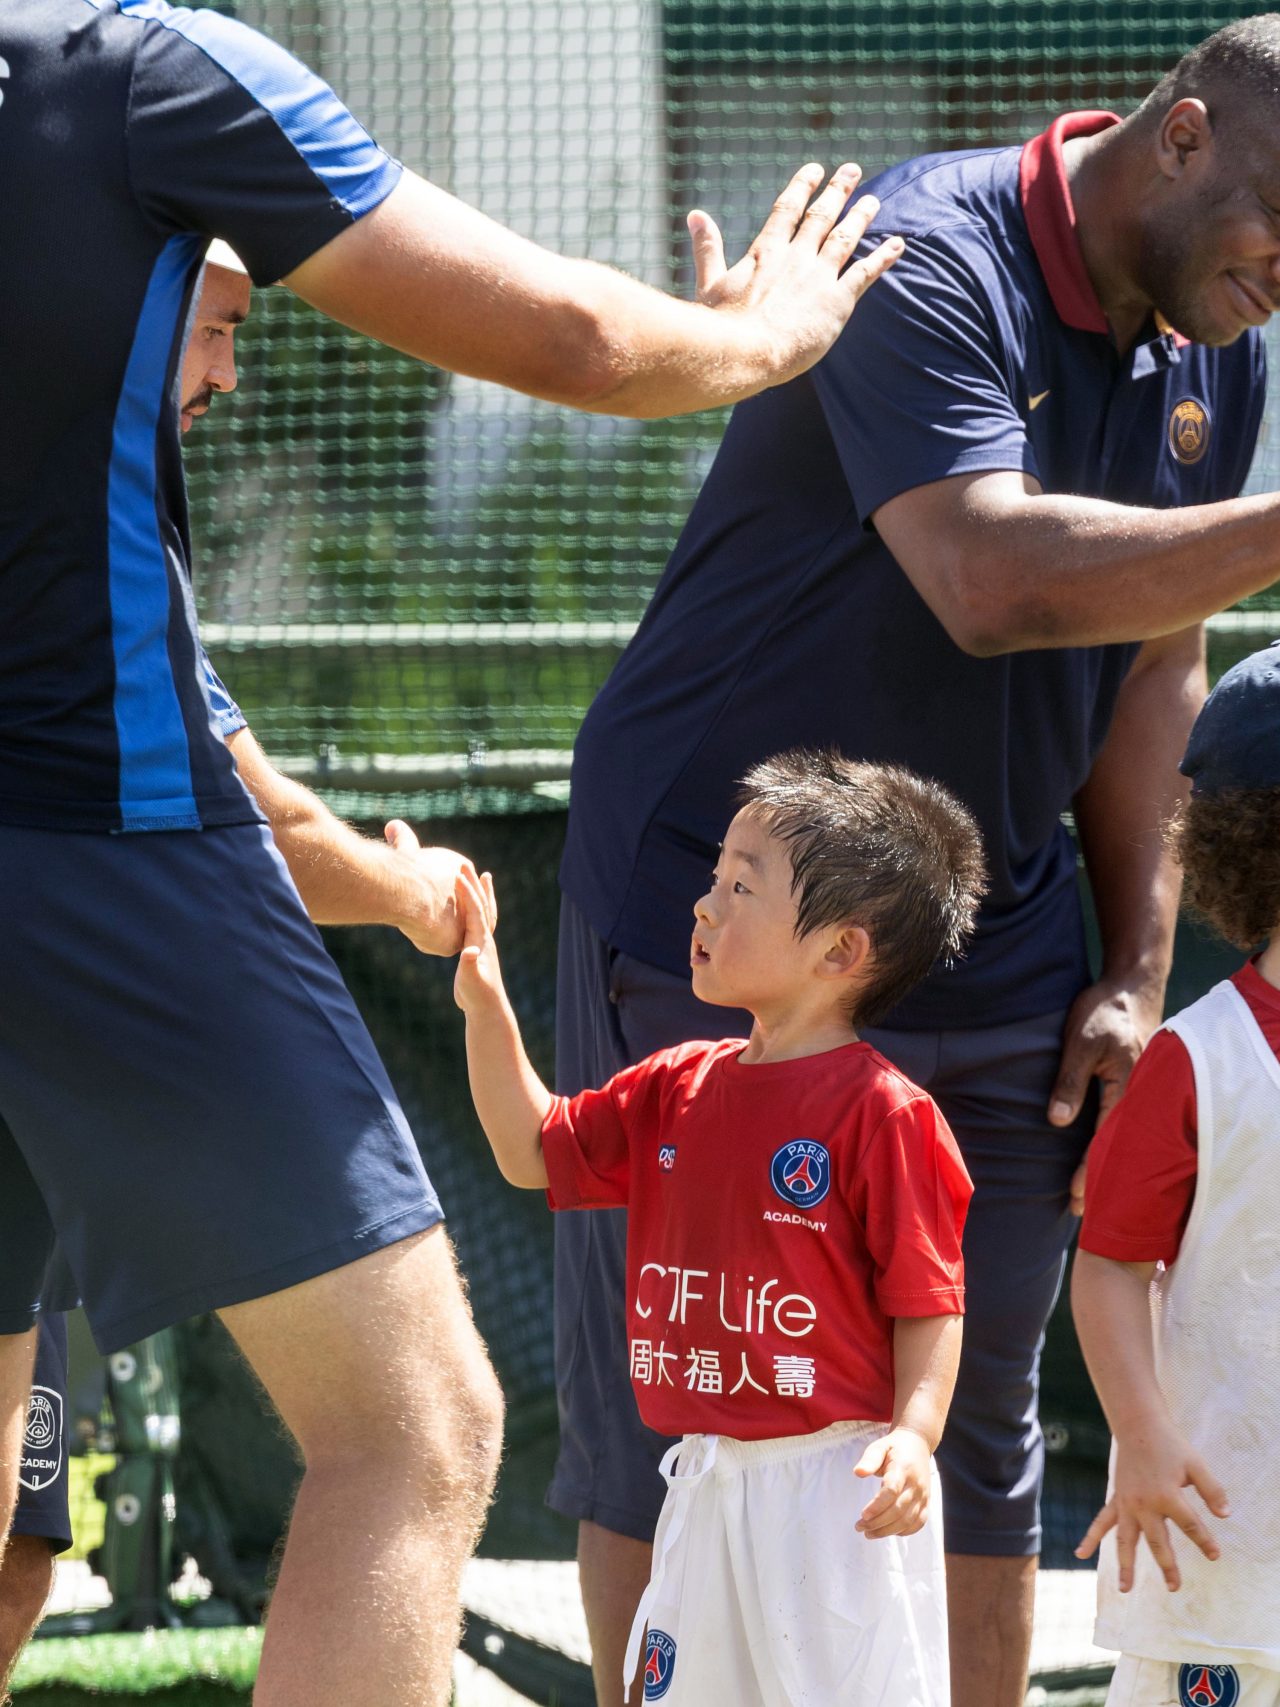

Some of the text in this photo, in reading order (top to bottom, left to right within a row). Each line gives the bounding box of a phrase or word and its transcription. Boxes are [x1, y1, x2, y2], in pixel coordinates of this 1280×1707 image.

[787, 1144, 827, 1163] PARIS
[763, 1211, 828, 1232] ACADEMY
[719, 1272, 817, 1337] Life
[630, 1339, 817, 1398] 周大福人壽
[28, 1398, 51, 1413] ARIS
[19, 1457, 57, 1470] CADEMY
